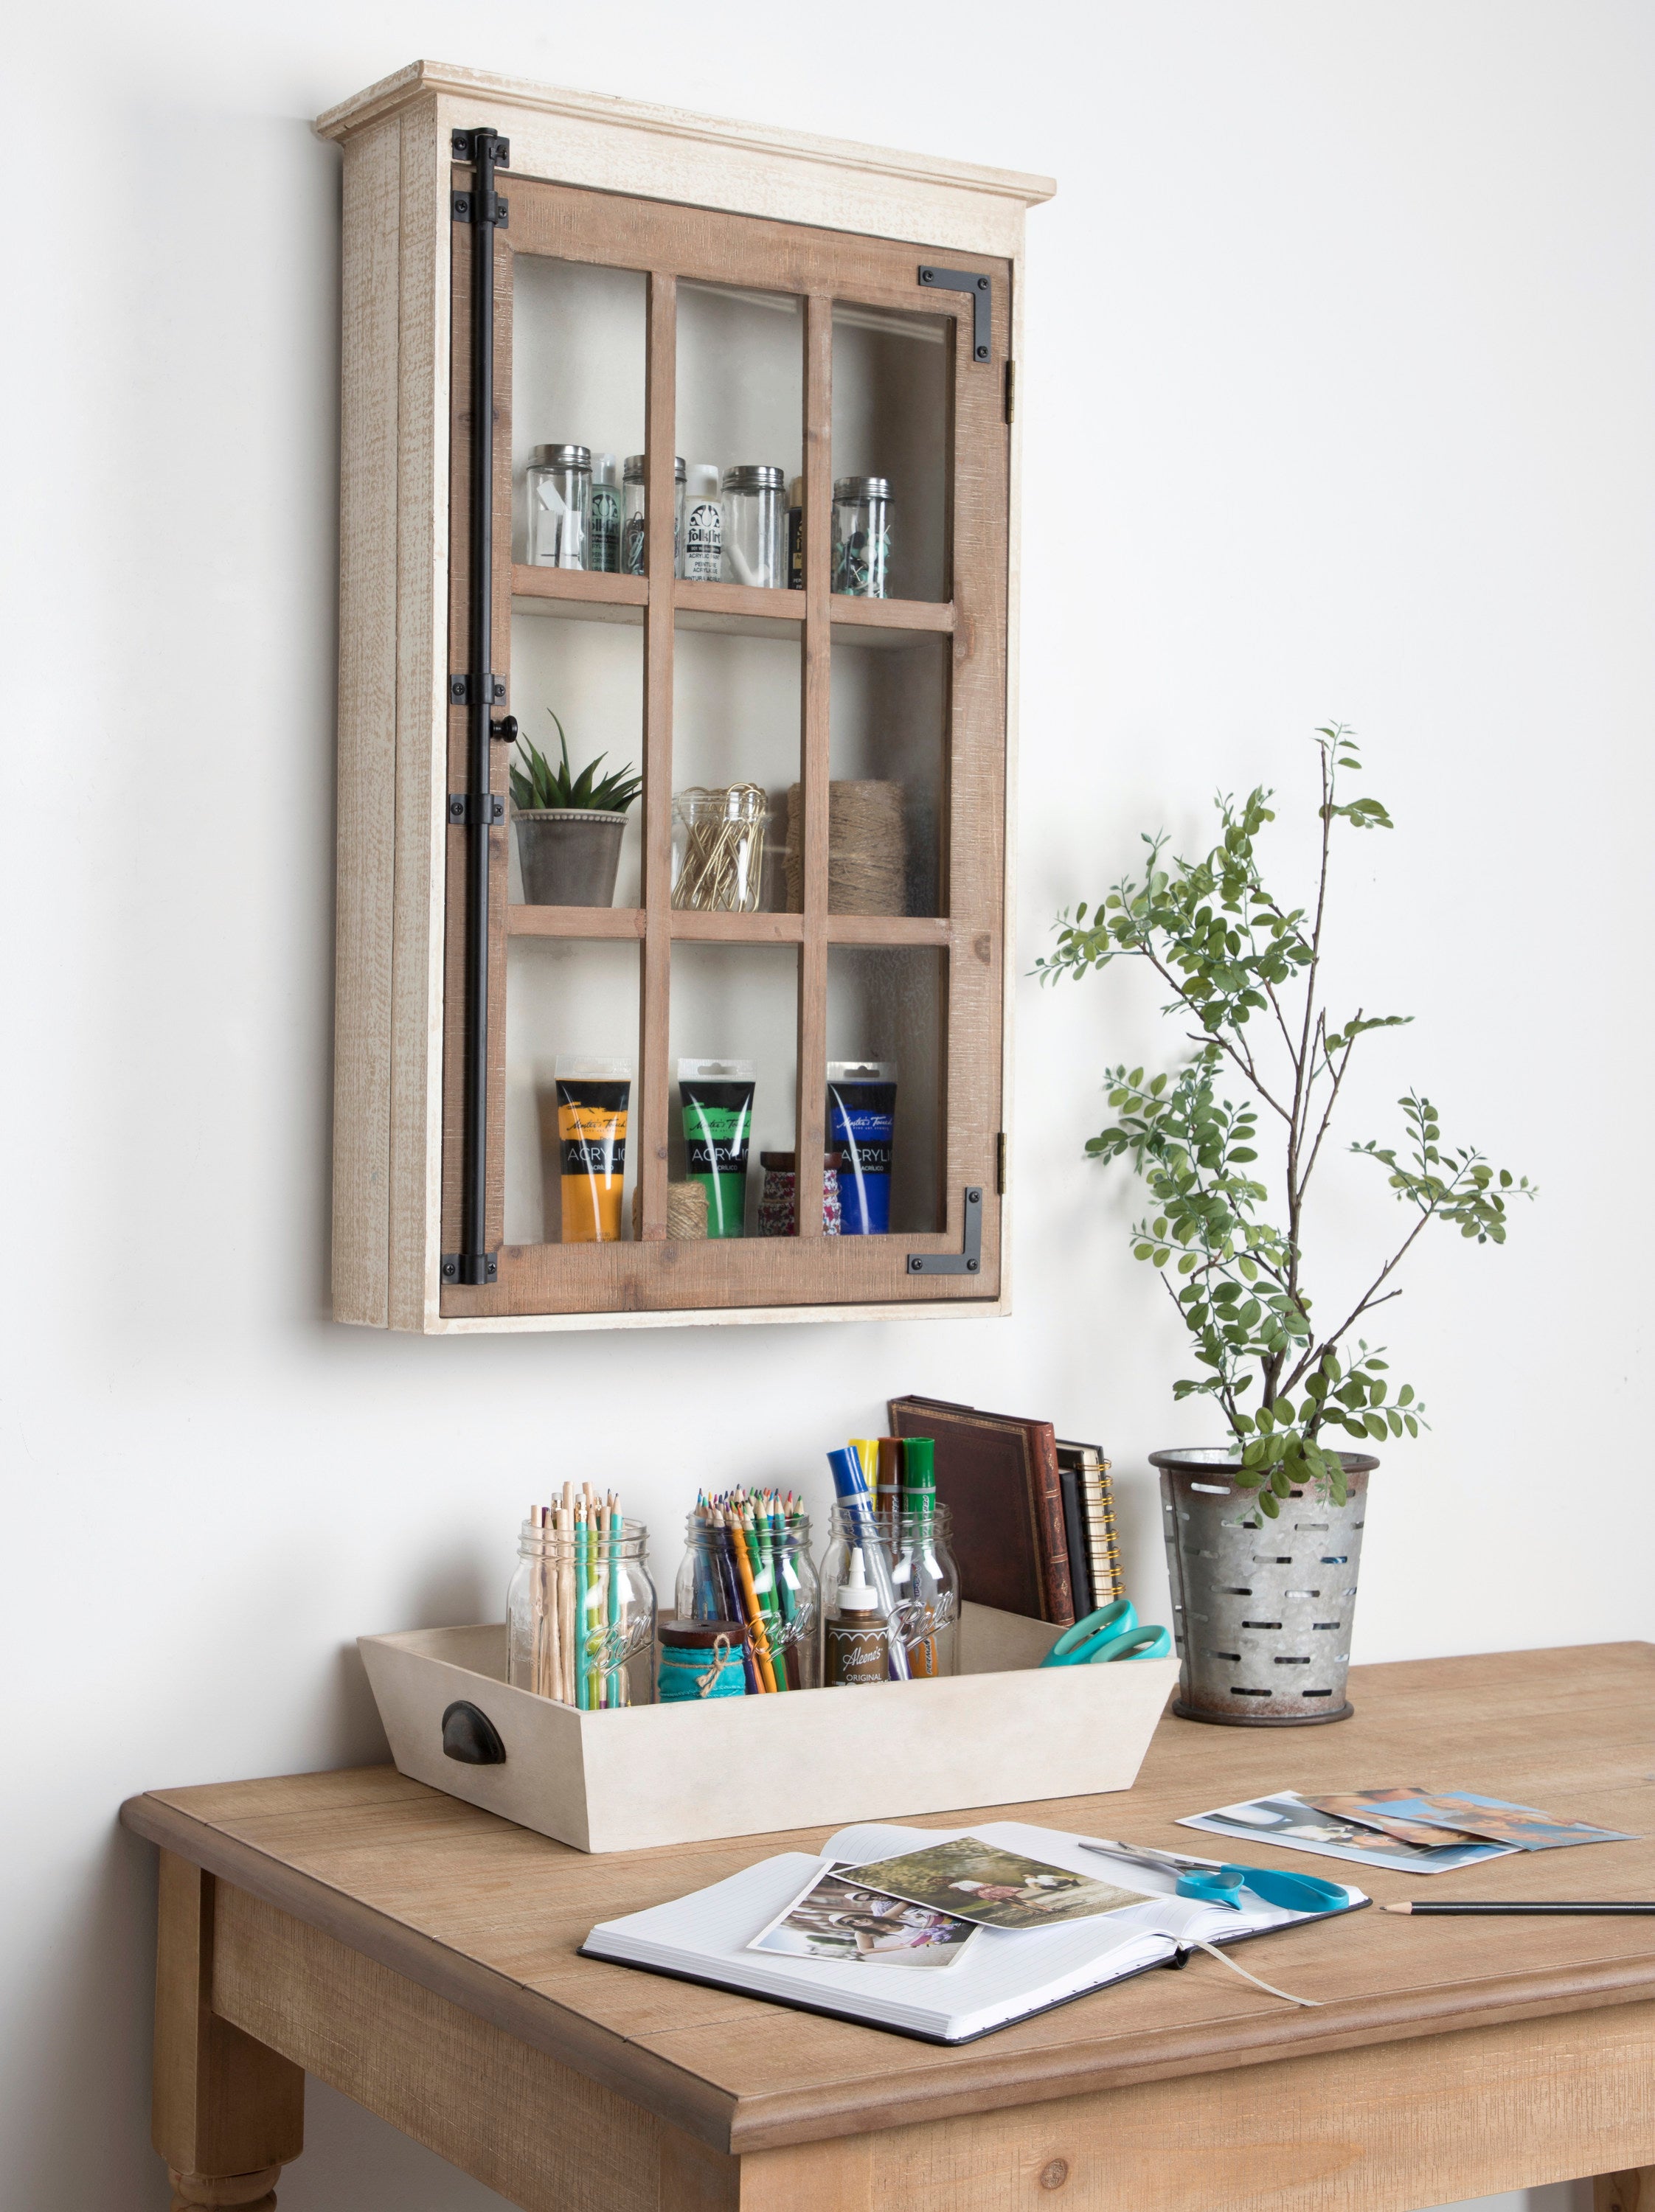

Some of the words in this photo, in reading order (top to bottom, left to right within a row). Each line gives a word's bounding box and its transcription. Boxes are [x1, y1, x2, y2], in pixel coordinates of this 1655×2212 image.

[566, 1118, 602, 1131] Master's
[836, 1116, 870, 1129] Master's
[870, 1116, 892, 1127] Touch
[585, 1614, 654, 1677] Ball
[842, 1646, 882, 1672] Aleene's
[923, 1638, 934, 1675] PERMAN
[846, 1674, 882, 1682] ORIGINAL
